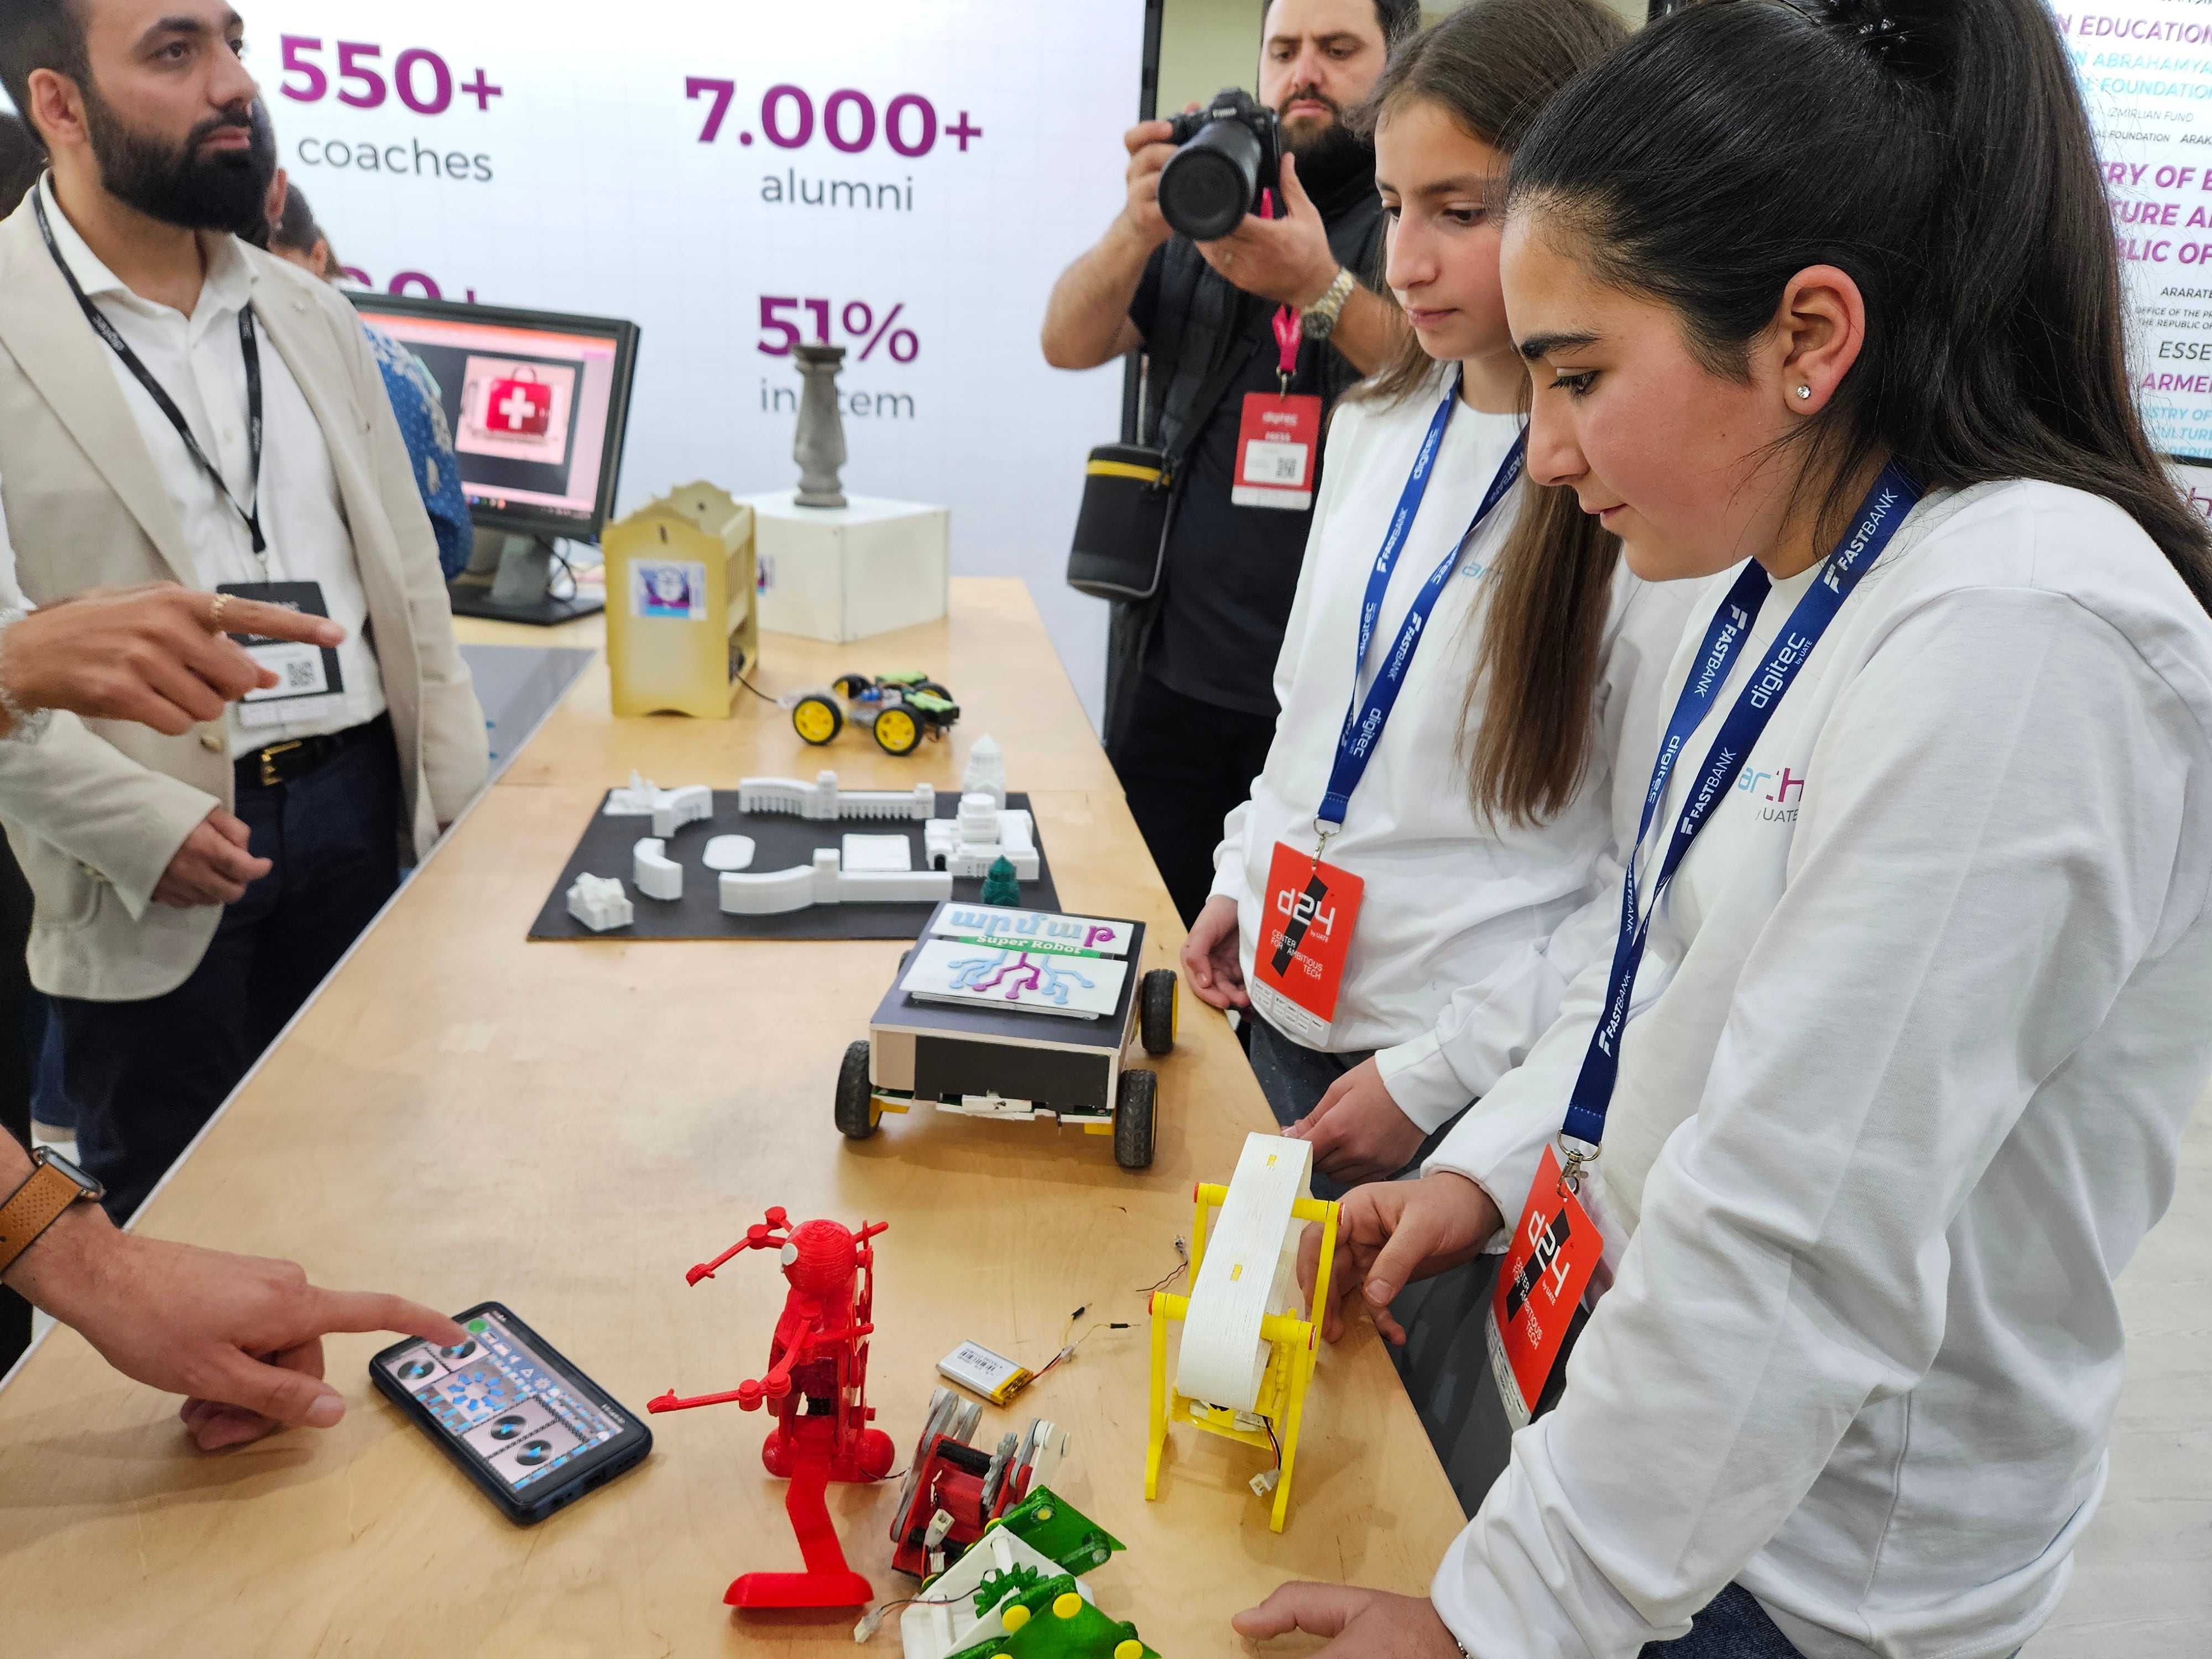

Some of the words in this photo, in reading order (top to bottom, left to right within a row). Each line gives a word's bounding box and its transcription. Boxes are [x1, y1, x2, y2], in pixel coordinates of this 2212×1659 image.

[280, 34, 502, 115] 550+
[685, 75, 983, 158] 7.000+
[2109, 130, 2171, 142] FOUNDATION
[2163, 111, 2194, 123] FUND
[298, 136, 493, 181] coaches
[2155, 165, 2197, 189] OF
[761, 167, 915, 212] alumni
[757, 295, 919, 363] 51%
[2157, 319, 2200, 330] REPUBLIC
[2168, 308, 2182, 317] OF
[2184, 309, 2201, 317] THE
[761, 378, 796, 412] in
[1381, 507, 1409, 560] FASTBANK
[1837, 487, 1898, 571] FASTBANK
[1387, 625, 1415, 682] FASTBANK
[1694, 623, 1738, 698] FASTBANK
[1750, 632, 1806, 709] digitec
[1799, 640, 1813, 657] UATE
[1353, 707, 1382, 758] digitec
[1650, 735, 1681, 805] digitec
[1690, 747, 1738, 818] FASTBANK
[1277, 888, 1336, 936] d24
[976, 935, 1029, 947] Super
[1030, 940, 1081, 954] Robot
[1270, 936, 1284, 950] FOR
[1286, 947, 1323, 972] AMBITIOUS
[1272, 929, 1296, 948] CENTER
[1316, 932, 1329, 943] UATE
[1303, 964, 1322, 980] TECH
[1606, 969, 1632, 1039] FASTBANK
[1528, 1210, 1571, 1297] d24
[1520, 1289, 1543, 1340] AMBITIOUS
[1526, 1319, 1539, 1350] TECH
